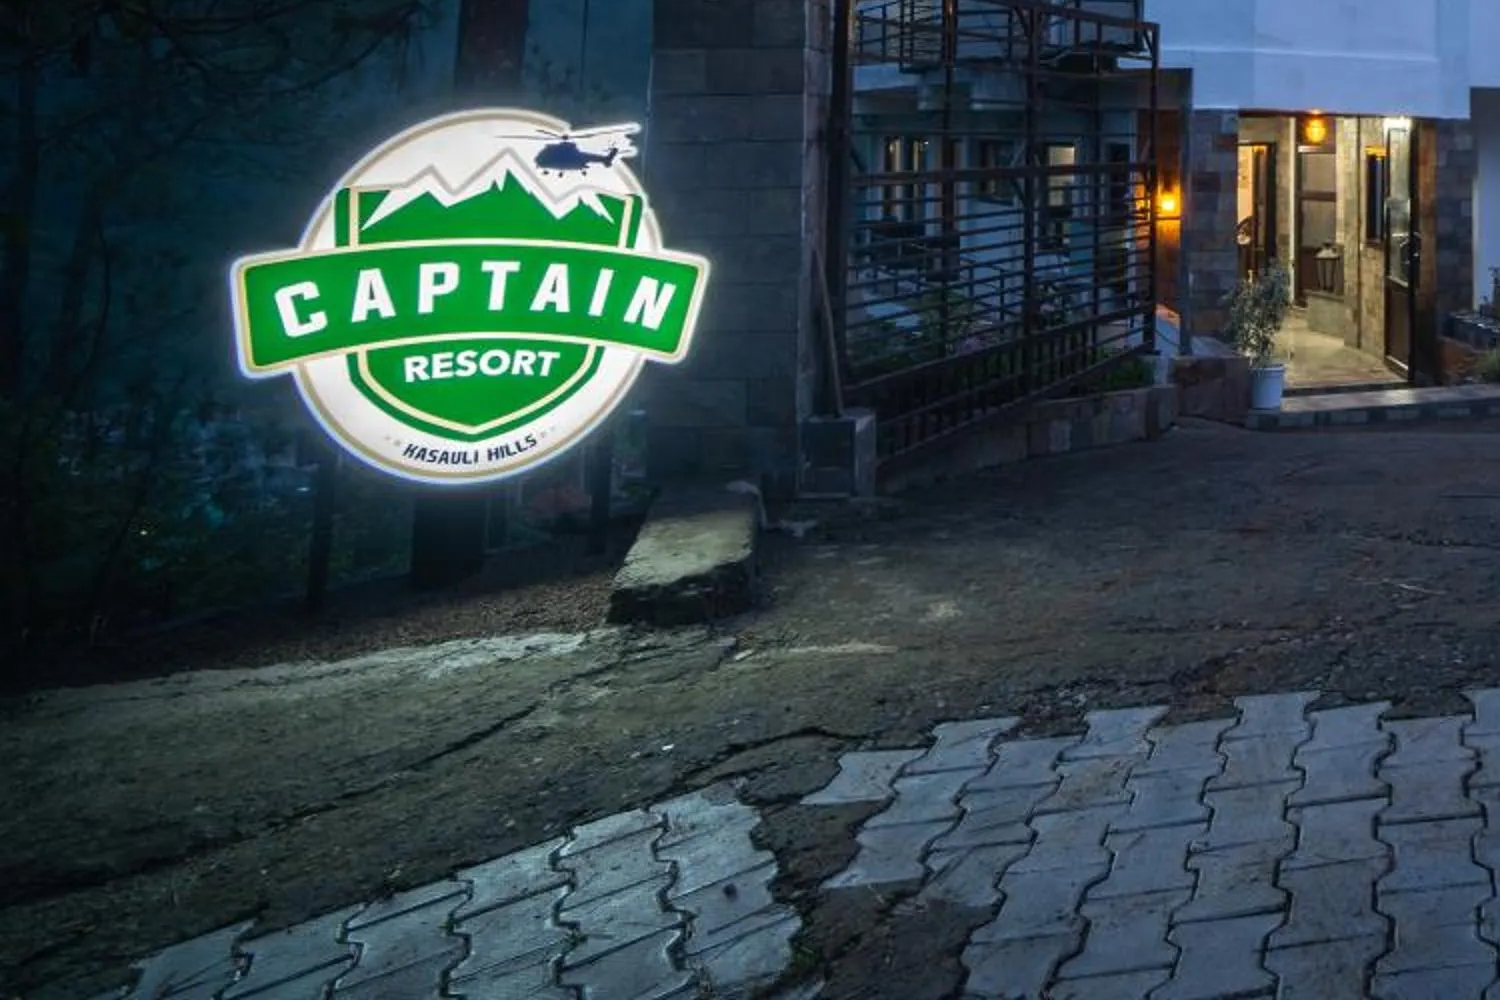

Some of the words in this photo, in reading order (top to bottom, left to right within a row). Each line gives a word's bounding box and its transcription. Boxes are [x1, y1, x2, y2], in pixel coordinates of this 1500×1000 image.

[274, 260, 677, 338] CAPTAIN
[404, 349, 560, 383] RESORT
[403, 443, 479, 465] KASAULI
[486, 433, 538, 462] HILLS
